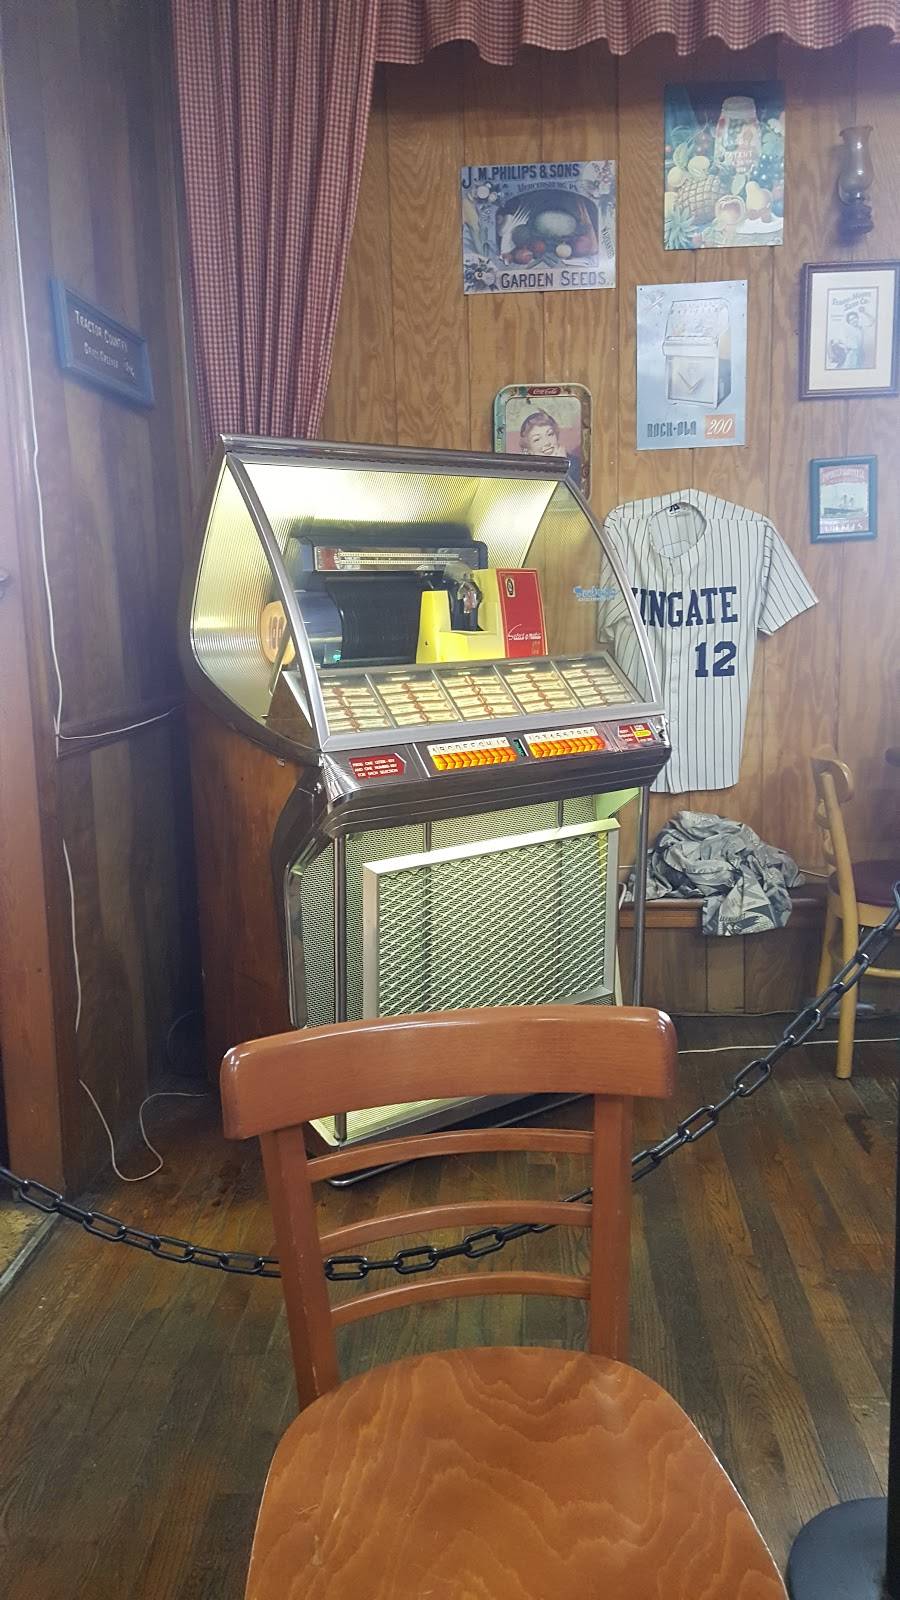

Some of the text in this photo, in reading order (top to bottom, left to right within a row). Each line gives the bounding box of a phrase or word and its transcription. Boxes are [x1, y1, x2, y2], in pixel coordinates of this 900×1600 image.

[539, 165, 549, 179] &
[549, 163, 580, 179] SONS
[501, 270, 606, 288] GARDEN SEEDS
[706, 418, 733, 435] 200
[631, 586, 738, 627] INGATE
[695, 641, 737, 678] 12
